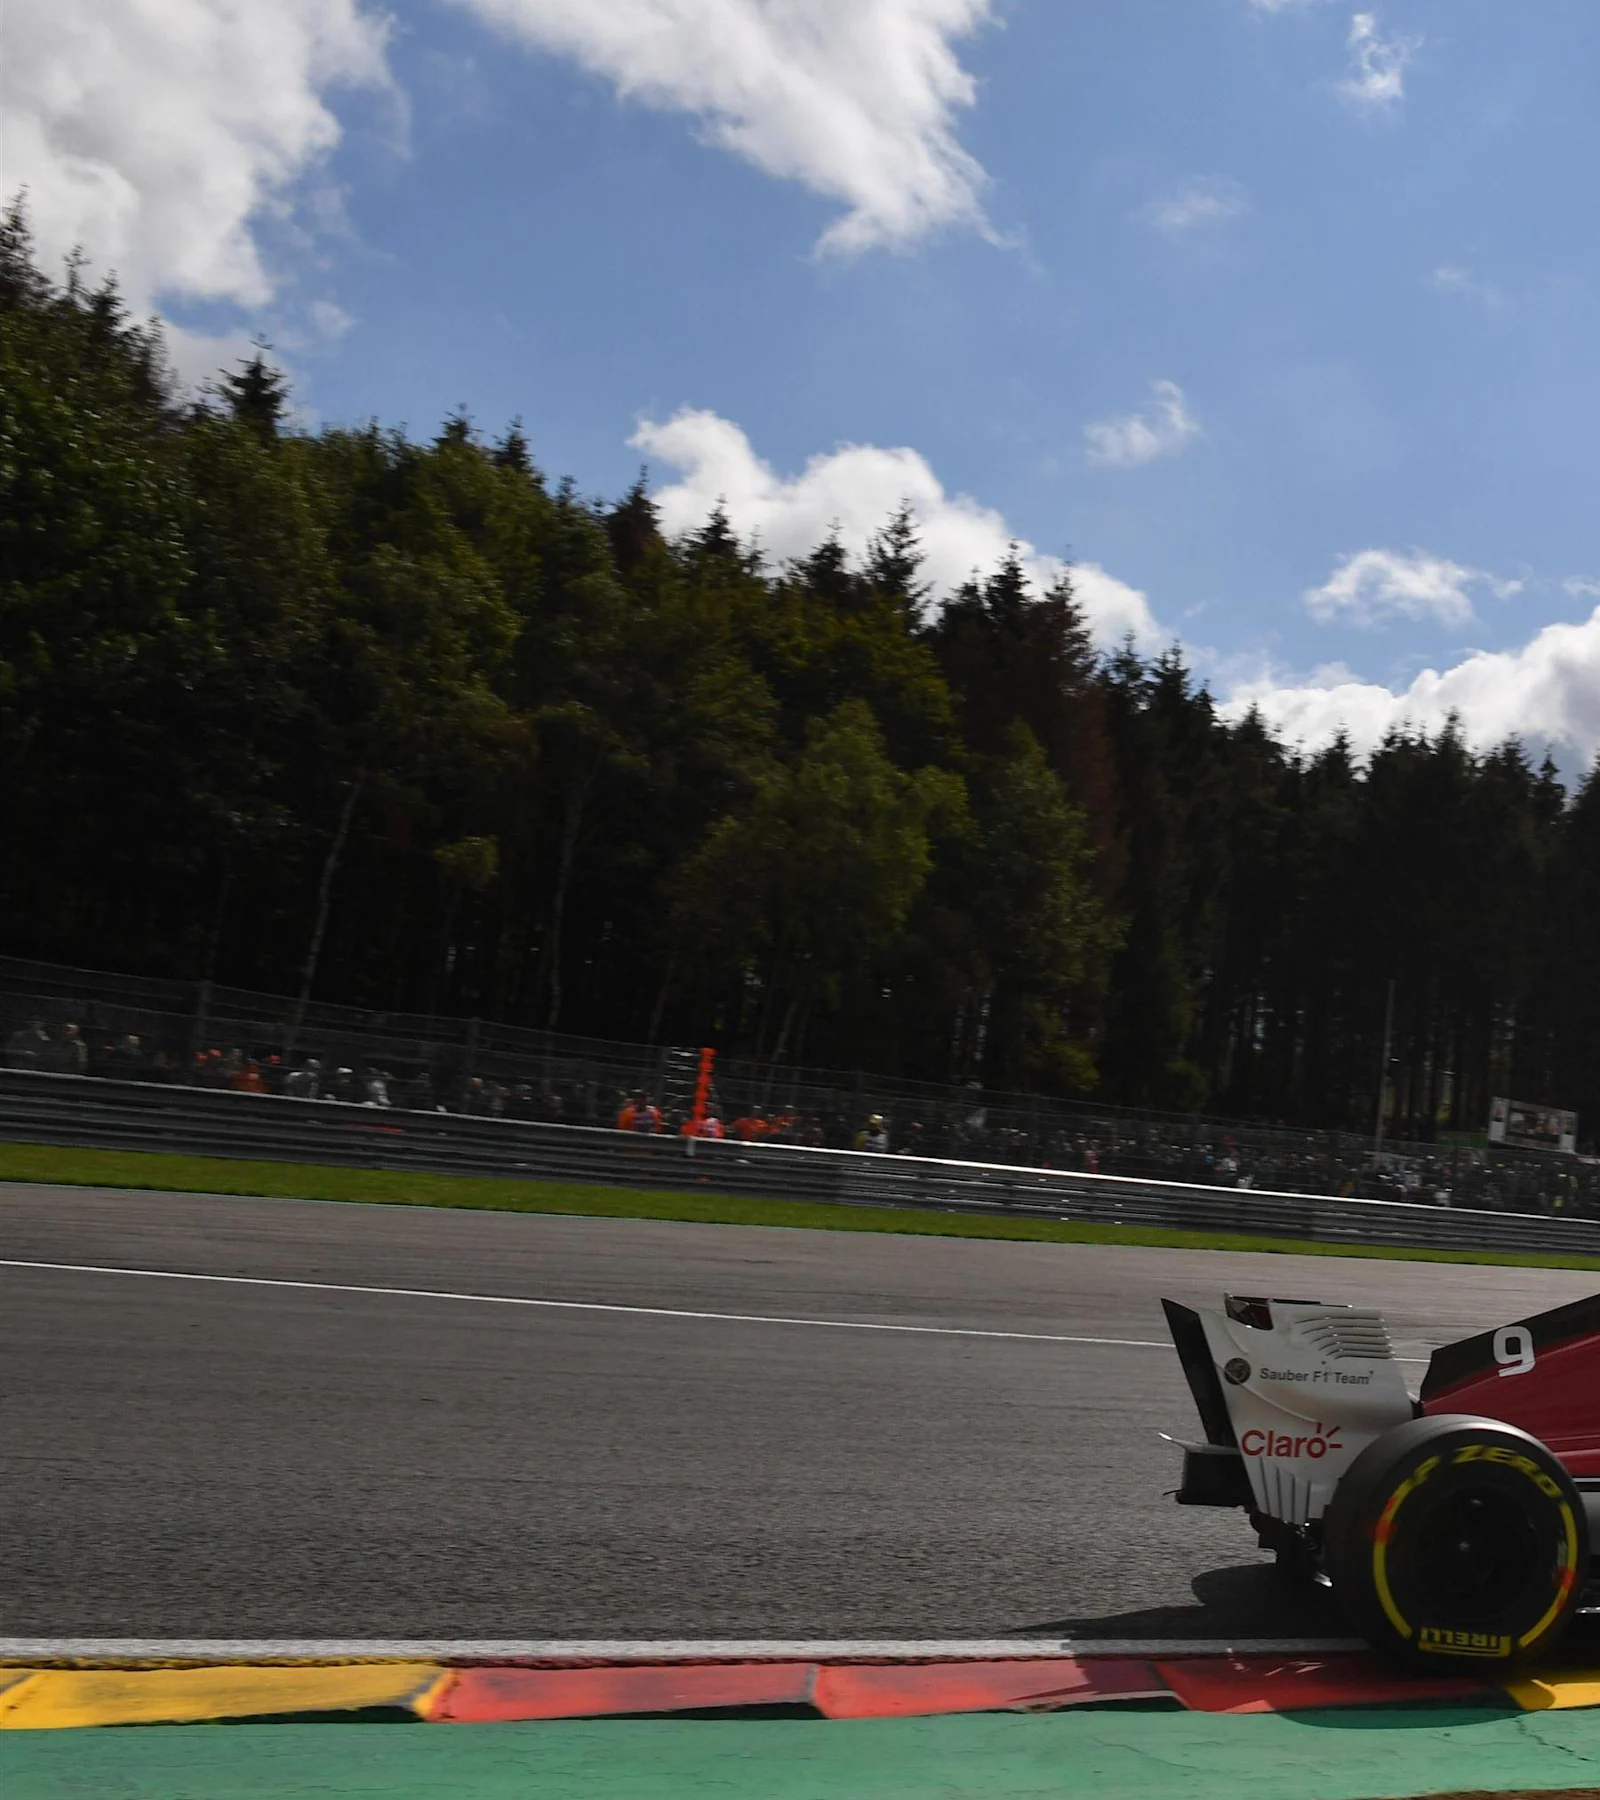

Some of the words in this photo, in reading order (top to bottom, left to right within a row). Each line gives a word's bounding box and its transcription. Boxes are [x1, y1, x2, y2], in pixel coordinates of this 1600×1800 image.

[1493, 1326, 1536, 1377] 9
[1260, 1368, 1310, 1382] Sauber
[1313, 1371, 1329, 1383] F1
[1335, 1372, 1370, 1385] Team
[1241, 1430, 1327, 1459] Claro
[1451, 1445, 1563, 1497] ZERO
[1421, 1626, 1511, 1656] PIRELLI
